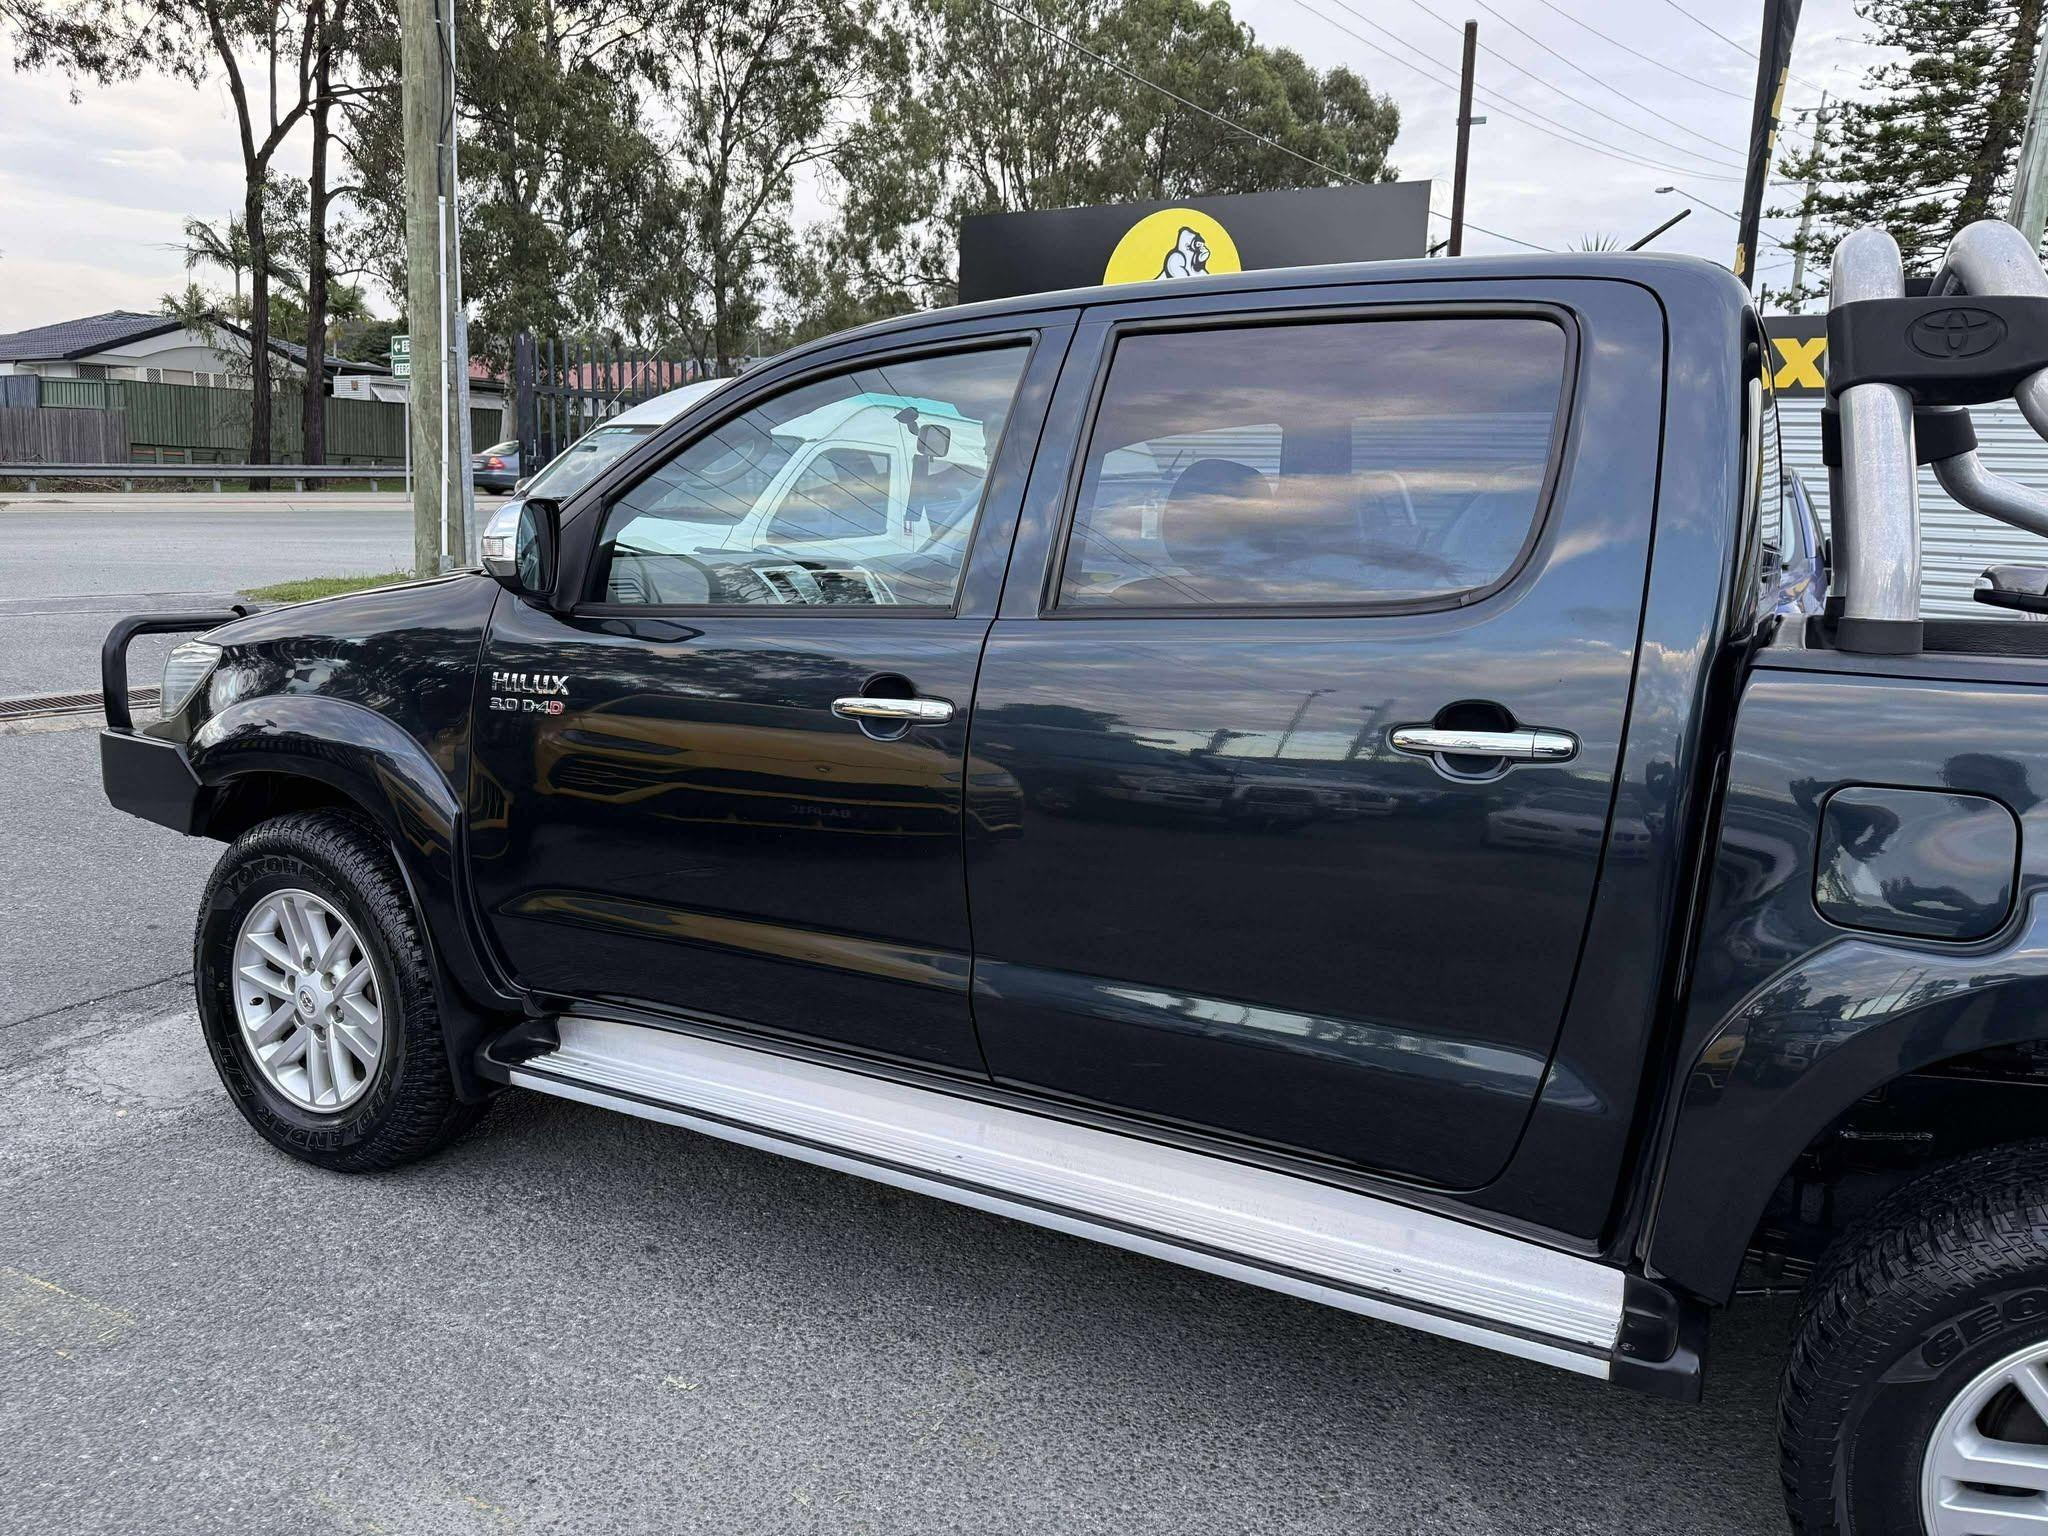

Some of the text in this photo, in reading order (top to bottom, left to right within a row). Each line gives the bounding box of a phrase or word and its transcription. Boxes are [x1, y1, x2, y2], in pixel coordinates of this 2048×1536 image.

[1761, 338, 1827, 388] X
[491, 671, 570, 696] HILUX
[489, 697, 566, 715] 3.0 D-4D
